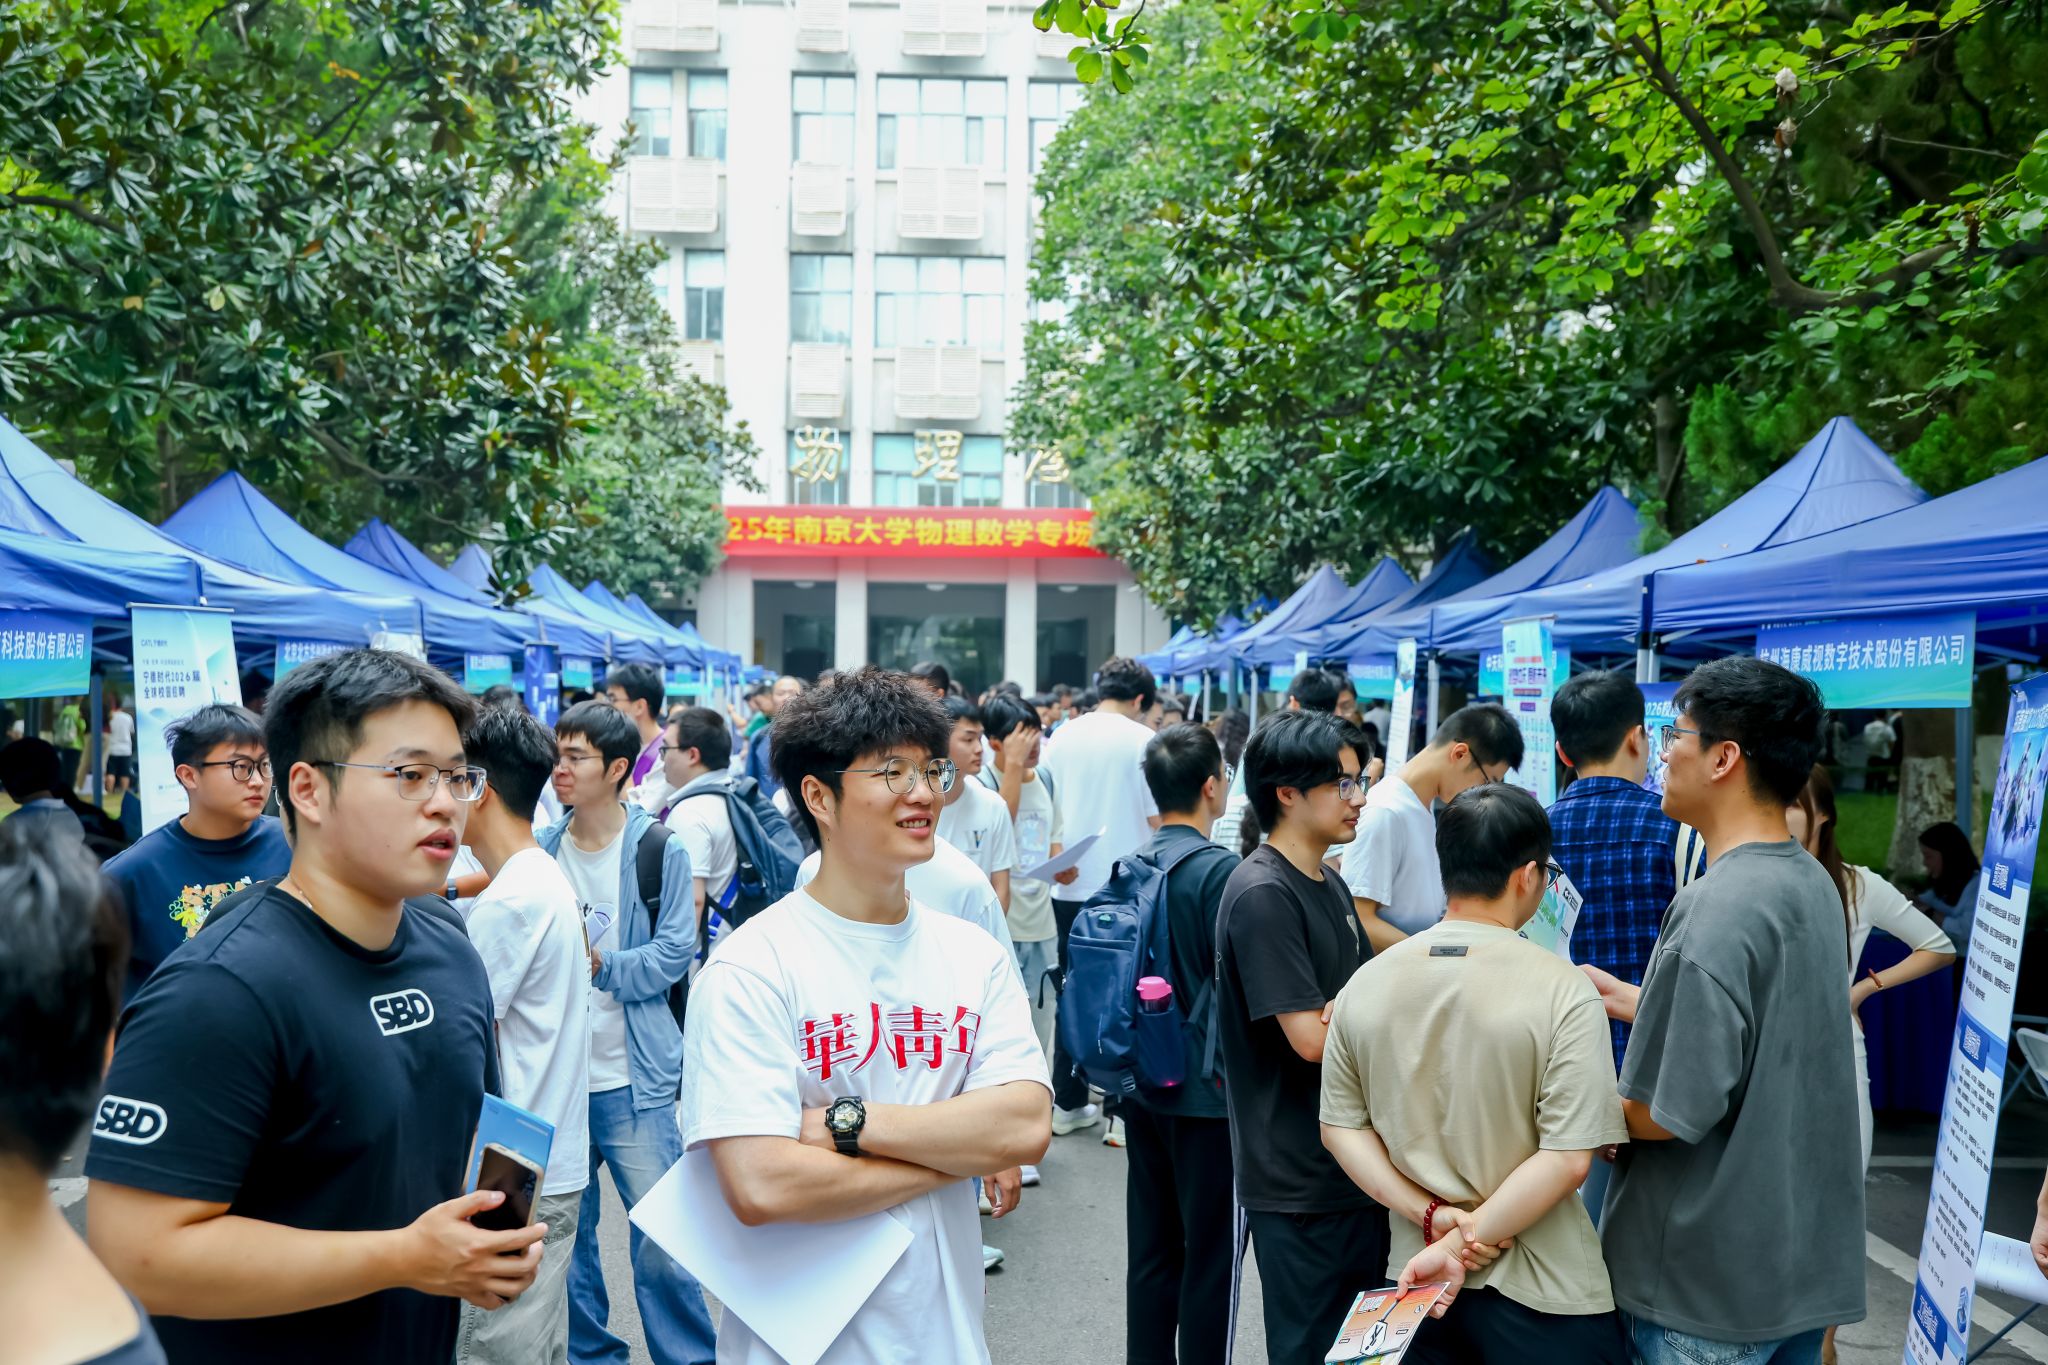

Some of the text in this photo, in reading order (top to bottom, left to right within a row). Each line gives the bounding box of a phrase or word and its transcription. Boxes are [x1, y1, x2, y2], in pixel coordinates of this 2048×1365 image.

[727, 515, 1092, 547] 25年南京大学物理数学专场
[0, 630, 85, 660] 科技股份有限公司
[372, 992, 431, 1032] SBD
[95, 1100, 162, 1139] SBD
